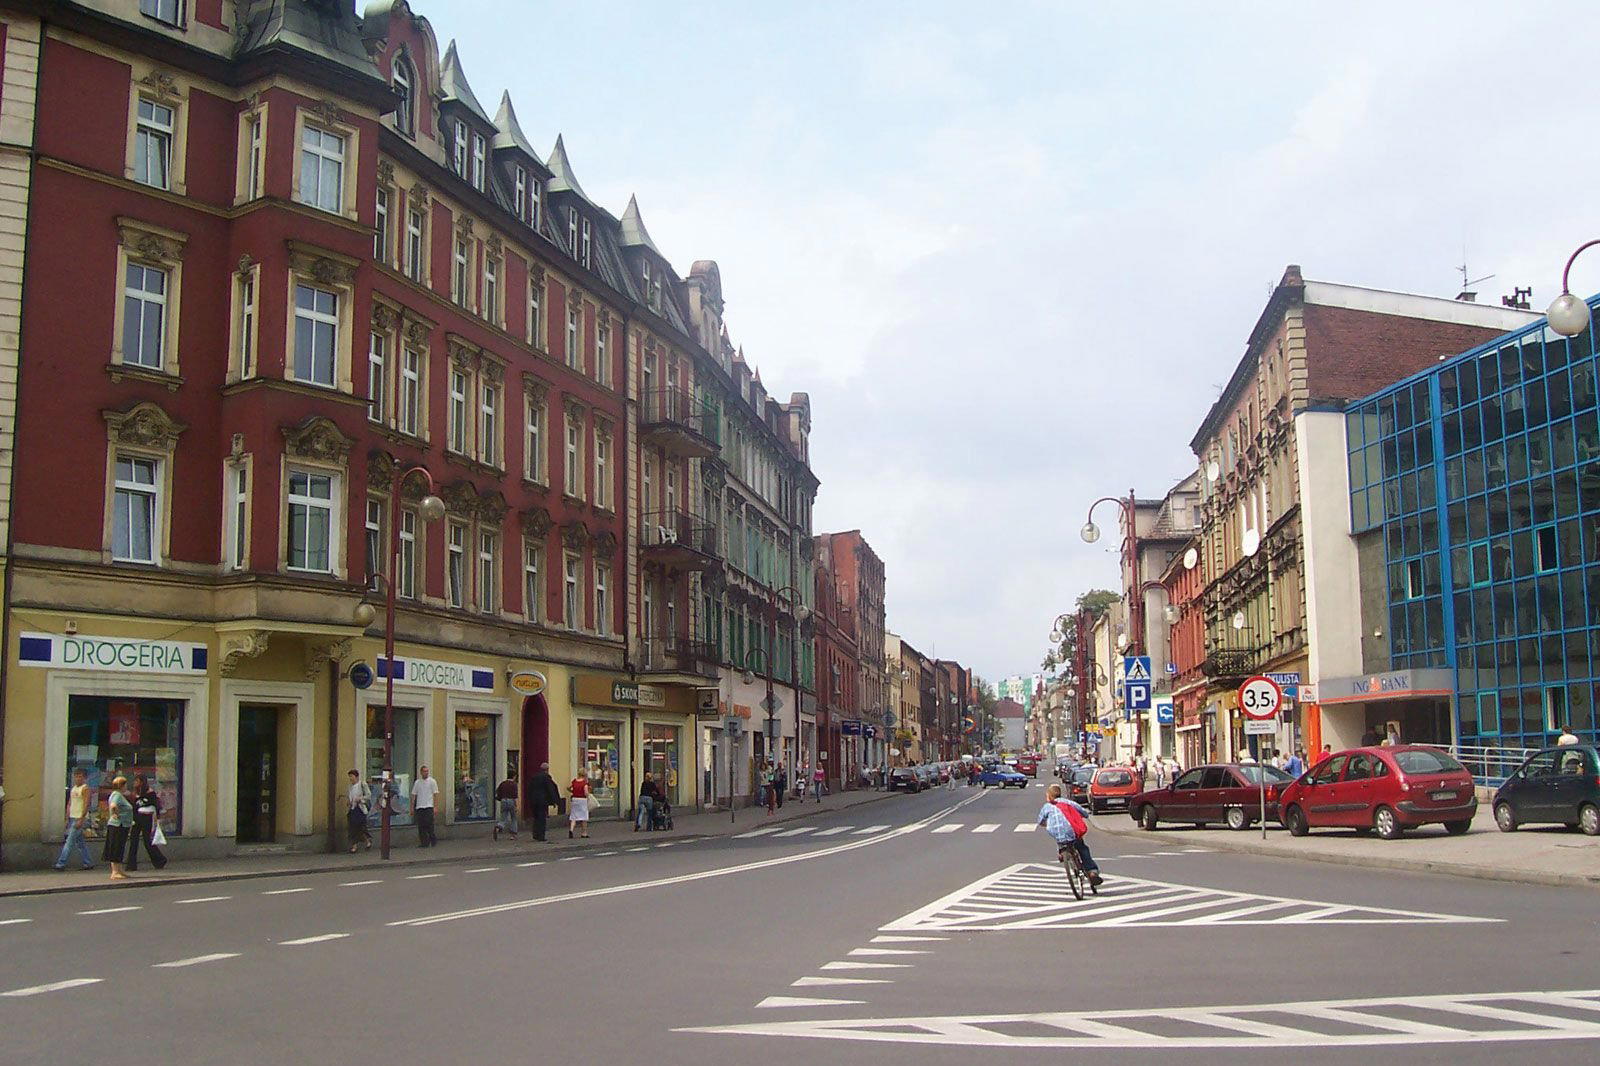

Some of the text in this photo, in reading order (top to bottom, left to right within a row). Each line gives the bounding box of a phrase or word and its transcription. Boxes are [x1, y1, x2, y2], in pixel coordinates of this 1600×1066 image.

[63, 640, 184, 669] DROGERIA
[410, 662, 465, 686] DROGERIA
[1352, 676, 1408, 694] ING BANK
[1131, 686, 1146, 707] P
